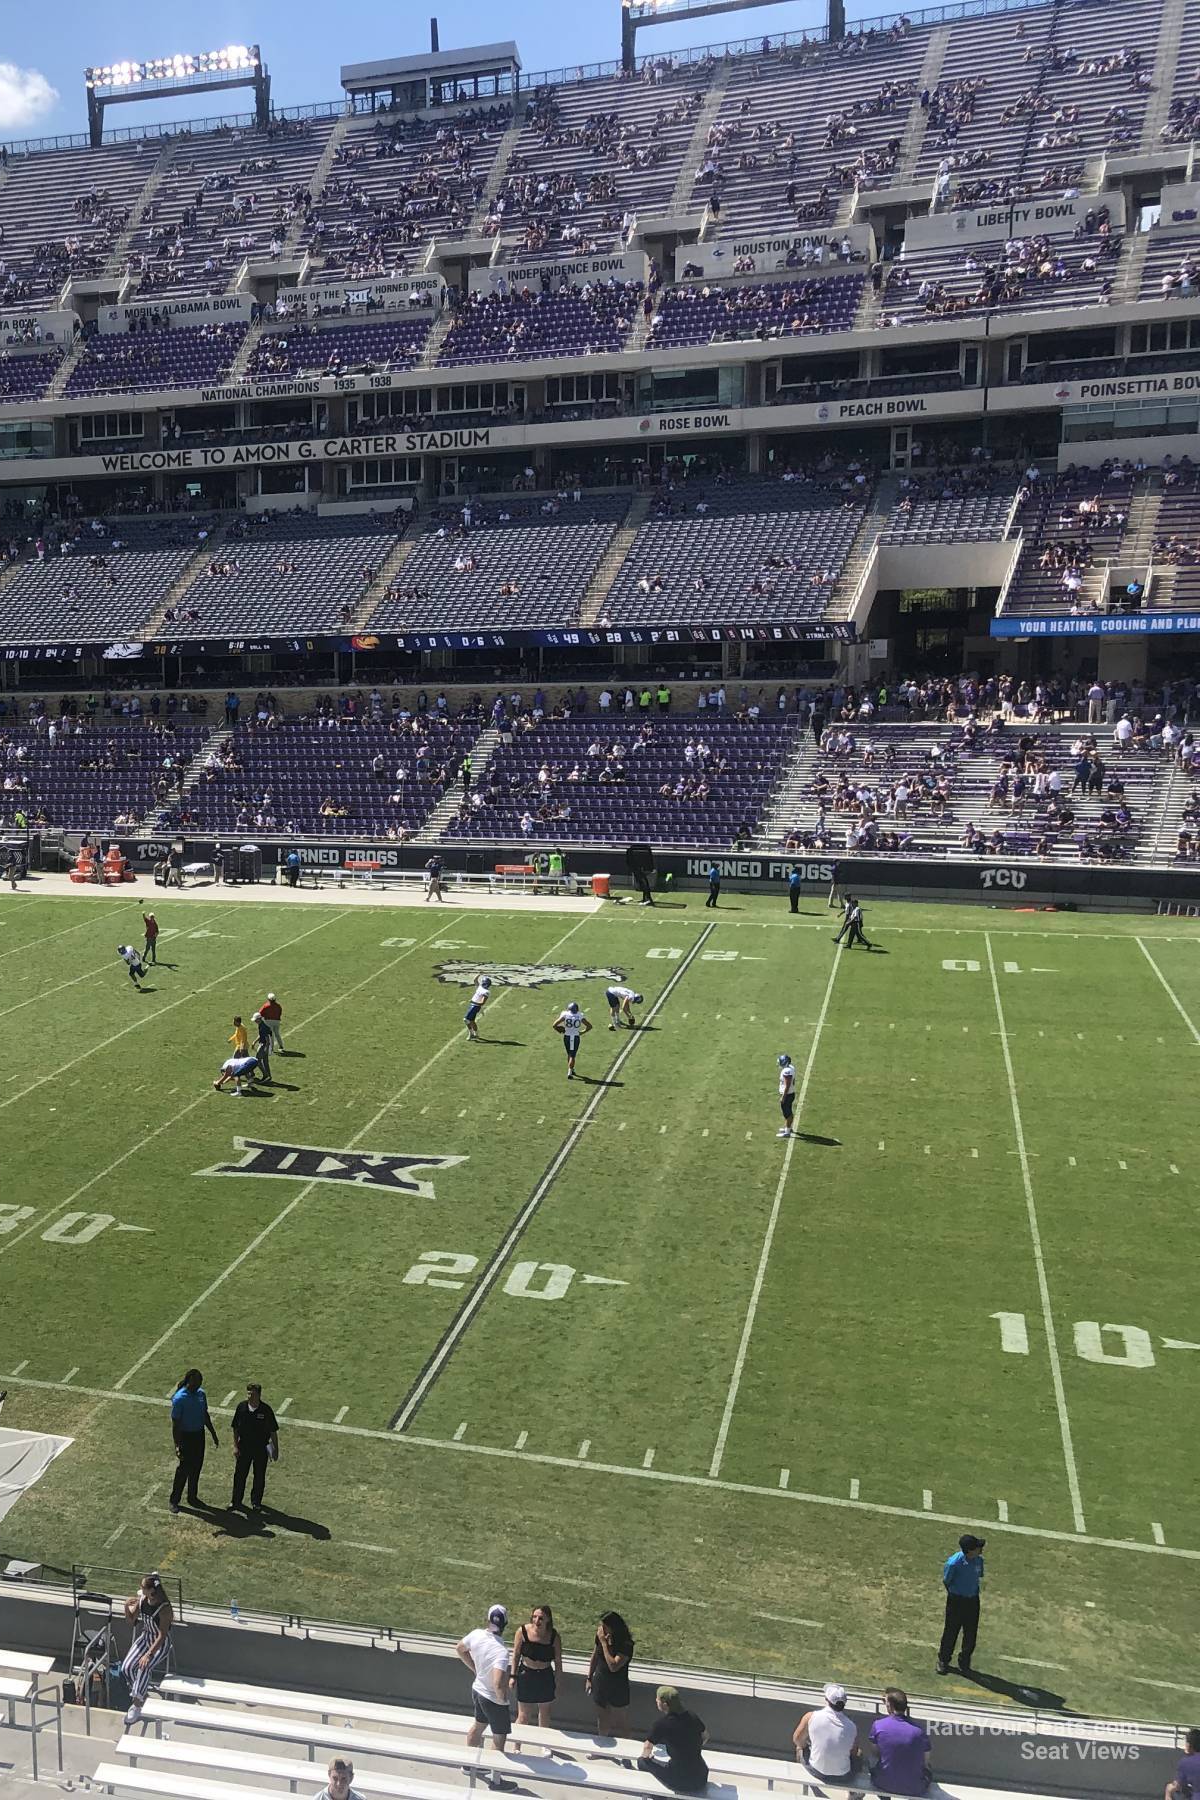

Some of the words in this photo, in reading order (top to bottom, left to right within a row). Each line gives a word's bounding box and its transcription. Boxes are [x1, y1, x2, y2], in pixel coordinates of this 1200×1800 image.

[976, 208, 1031, 227] LIBERTY
[1035, 204, 1077, 220] BOWL
[733, 239, 790, 257] HOUSTON
[793, 234, 831, 249] BOWL
[507, 262, 589, 281] INDEPENDENCE
[592, 259, 626, 272] BOWL
[281, 293, 307, 304] HOME
[310, 292, 321, 302] OF
[323, 290, 340, 300] THE
[375, 282, 408, 294] HORNED
[411, 279, 438, 291] FROGS
[124, 301, 160, 317] MOBILE
[162, 300, 212, 316] ALABAMA
[213, 297, 242, 311] BOWL
[202, 386, 254, 401] NATIONAL
[255, 382, 320, 398] CHAMPIONS
[333, 378, 356, 390] 1935
[369, 376, 392, 388] 1938
[1080, 379, 1169, 398] POINSETTIA
[839, 403, 883, 417] PEACH
[886, 399, 927, 414] BOWL
[659, 418, 690, 431] ROSE
[693, 415, 730, 429] BOWL
[101, 451, 192, 471] WELCOME
[202, 449, 225, 464] TO
[233, 444, 289, 463] AMON
[298, 443, 317, 459] G.
[323, 436, 397, 457] CARTER
[406, 430, 490, 451] STADIUM
[773, 628, 782, 638] 6
[1019, 621, 1046, 633] YOUR
[1050, 620, 1097, 633] HEATING,
[1101, 619, 1147, 631] COOLING
[1151, 618, 1173, 630] AND
[429, 637, 436, 647] 0
[563, 634, 579, 644] 49
[606, 633, 622, 642] 28
[666, 631, 680, 641] 21
[712, 630, 721, 640] 0
[741, 629, 754, 639] 14
[397, 638, 405, 648] 2
[277, 848, 339, 863] HRNED
[345, 849, 398, 865] FROGS
[524, 853, 549, 868] TC
[687, 859, 761, 878] HORNED
[769, 862, 831, 880] FROGS
[980, 868, 1027, 889] TCU
[379, 937, 468, 949] 30
[645, 948, 739, 961] 20
[942, 959, 1024, 973] 10
[565, 1019, 580, 1029] 80
[401, 1250, 577, 1301] 20
[988, 1311, 1156, 1368] 10
